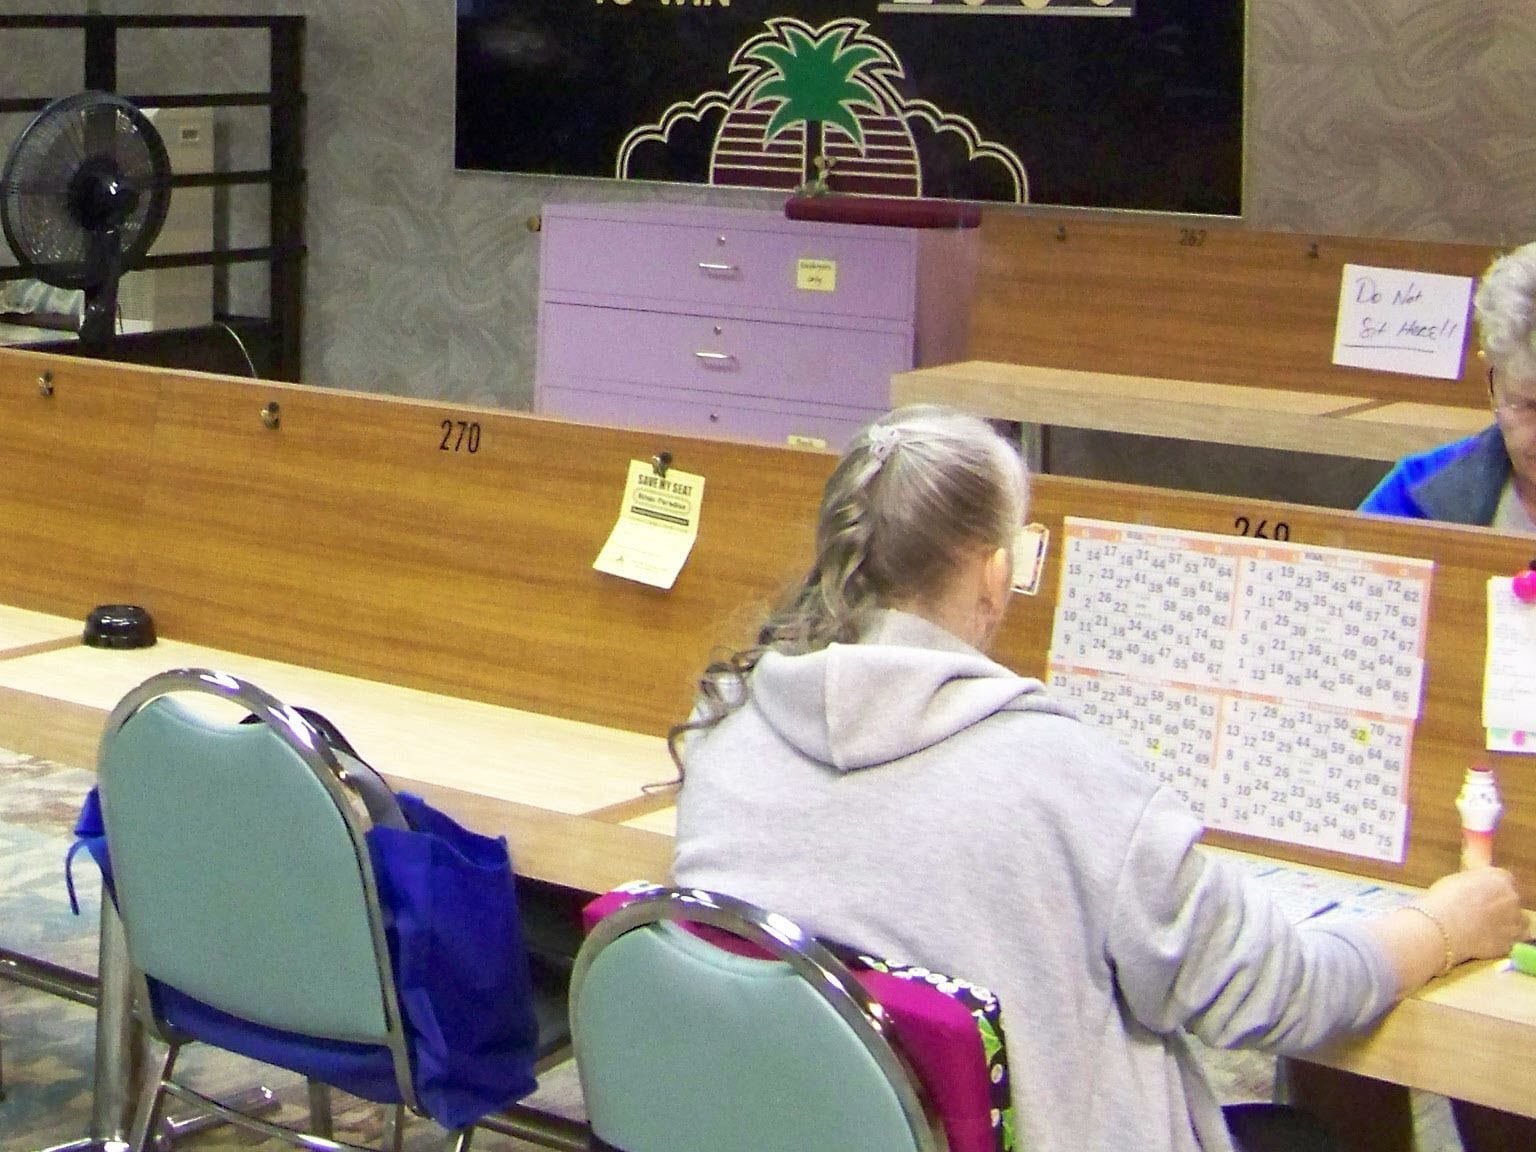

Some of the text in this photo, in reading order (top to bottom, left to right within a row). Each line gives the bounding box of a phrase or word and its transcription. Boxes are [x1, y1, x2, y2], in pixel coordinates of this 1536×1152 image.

[440, 419, 481, 453] 270
[638, 474, 658, 488] SAVE
[672, 483, 692, 496] SEAT
[1168, 553, 1182, 564] 57
[1387, 580, 1401, 592] 72
[1381, 630, 1396, 641] 74
